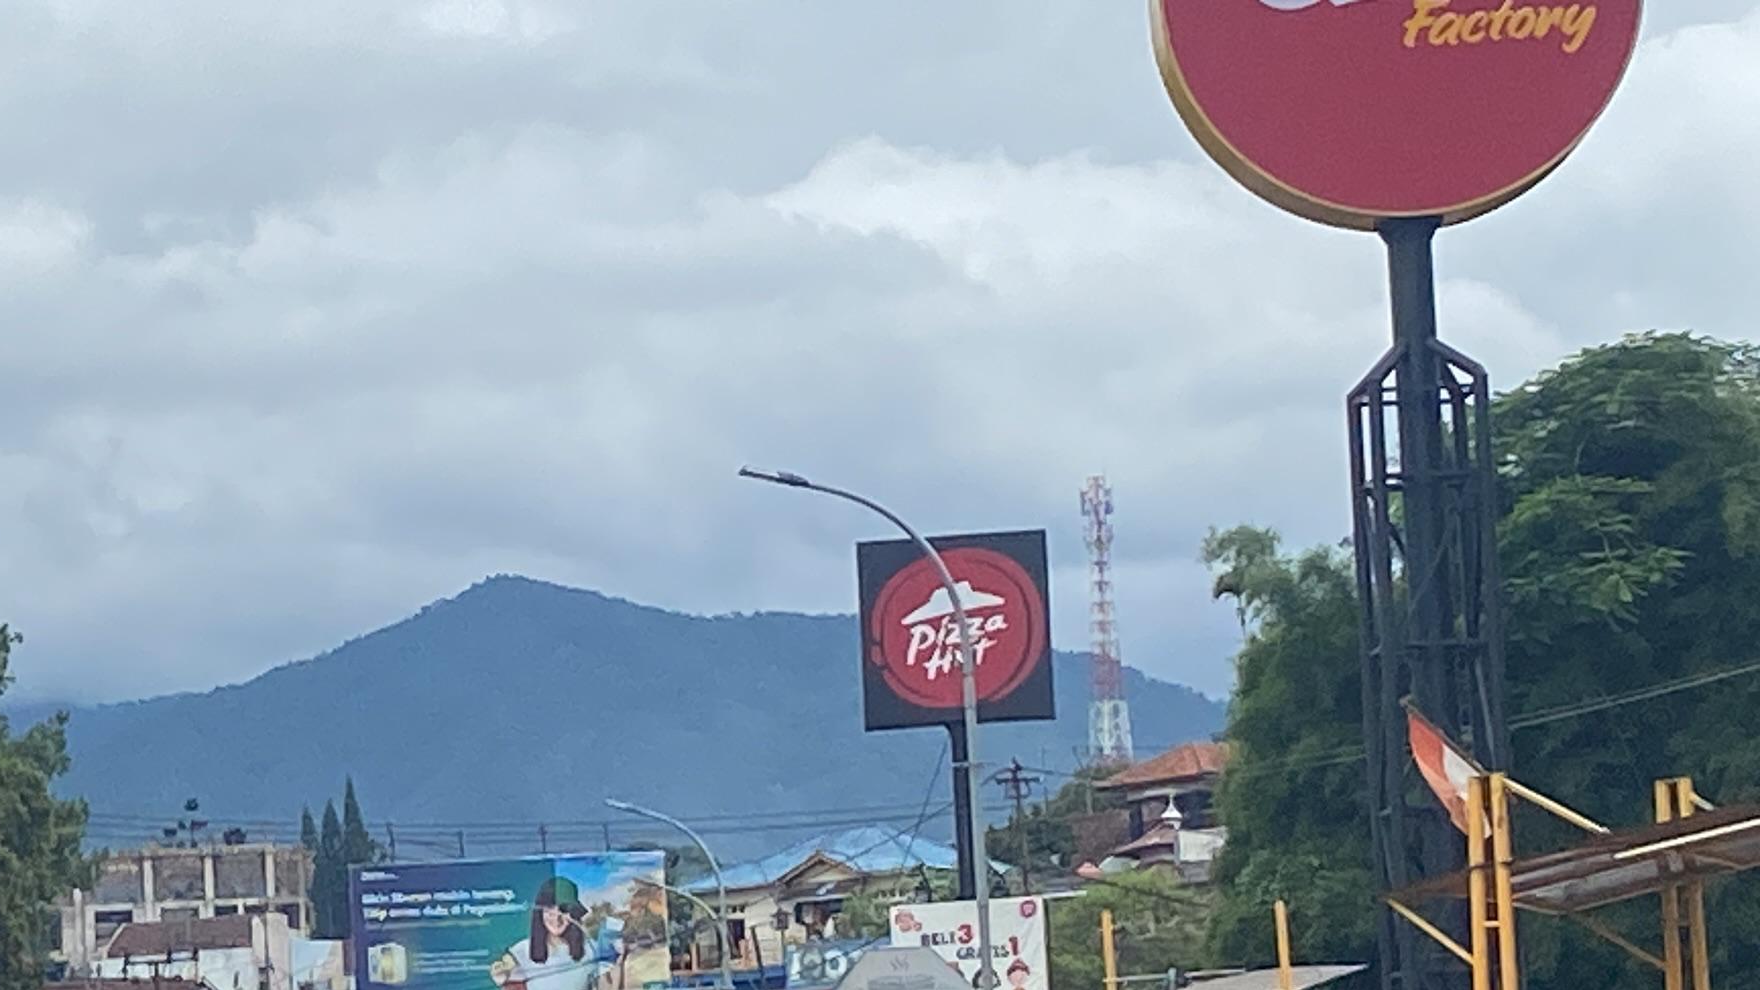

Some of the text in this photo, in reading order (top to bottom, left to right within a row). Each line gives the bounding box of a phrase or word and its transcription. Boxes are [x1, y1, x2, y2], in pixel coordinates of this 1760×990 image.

[1402, 0, 1597, 53] Factory
[907, 614, 1008, 666] Pizza
[956, 935, 1019, 960] GRIS 1
[958, 923, 973, 944] 3
